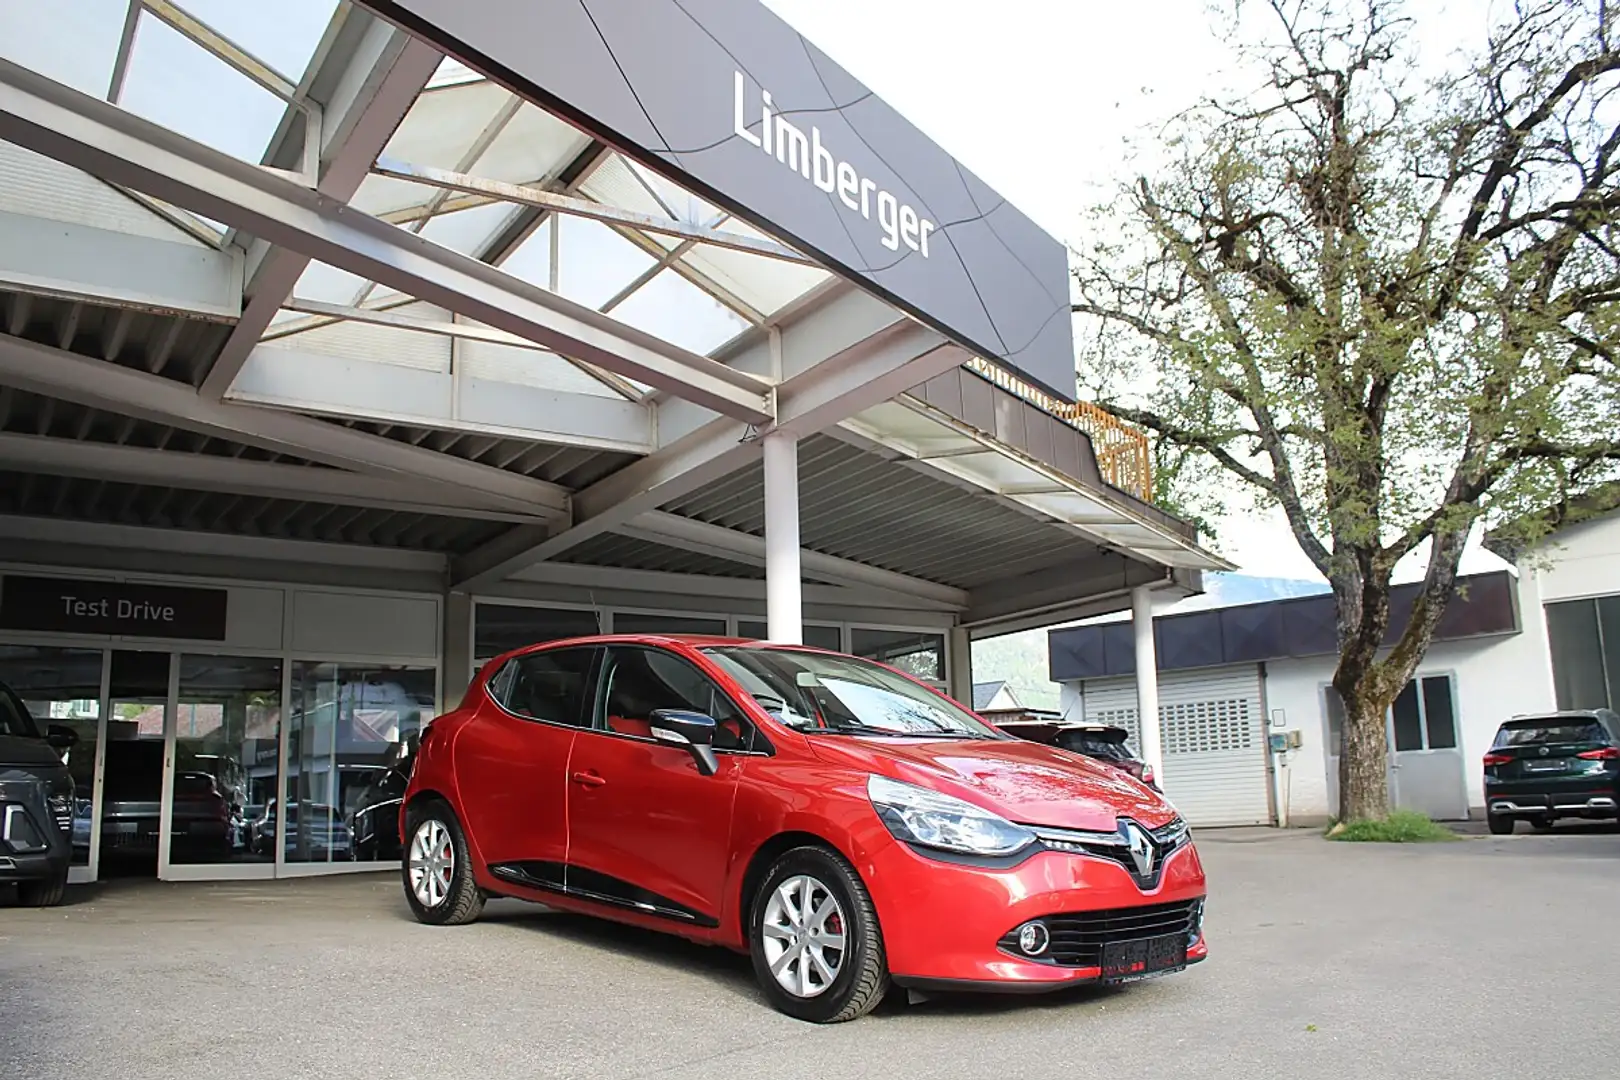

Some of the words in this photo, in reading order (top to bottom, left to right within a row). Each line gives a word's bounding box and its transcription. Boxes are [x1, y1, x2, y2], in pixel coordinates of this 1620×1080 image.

[734, 70, 934, 258] Limberger
[61, 596, 109, 617] Test
[117, 599, 175, 621] Drive
